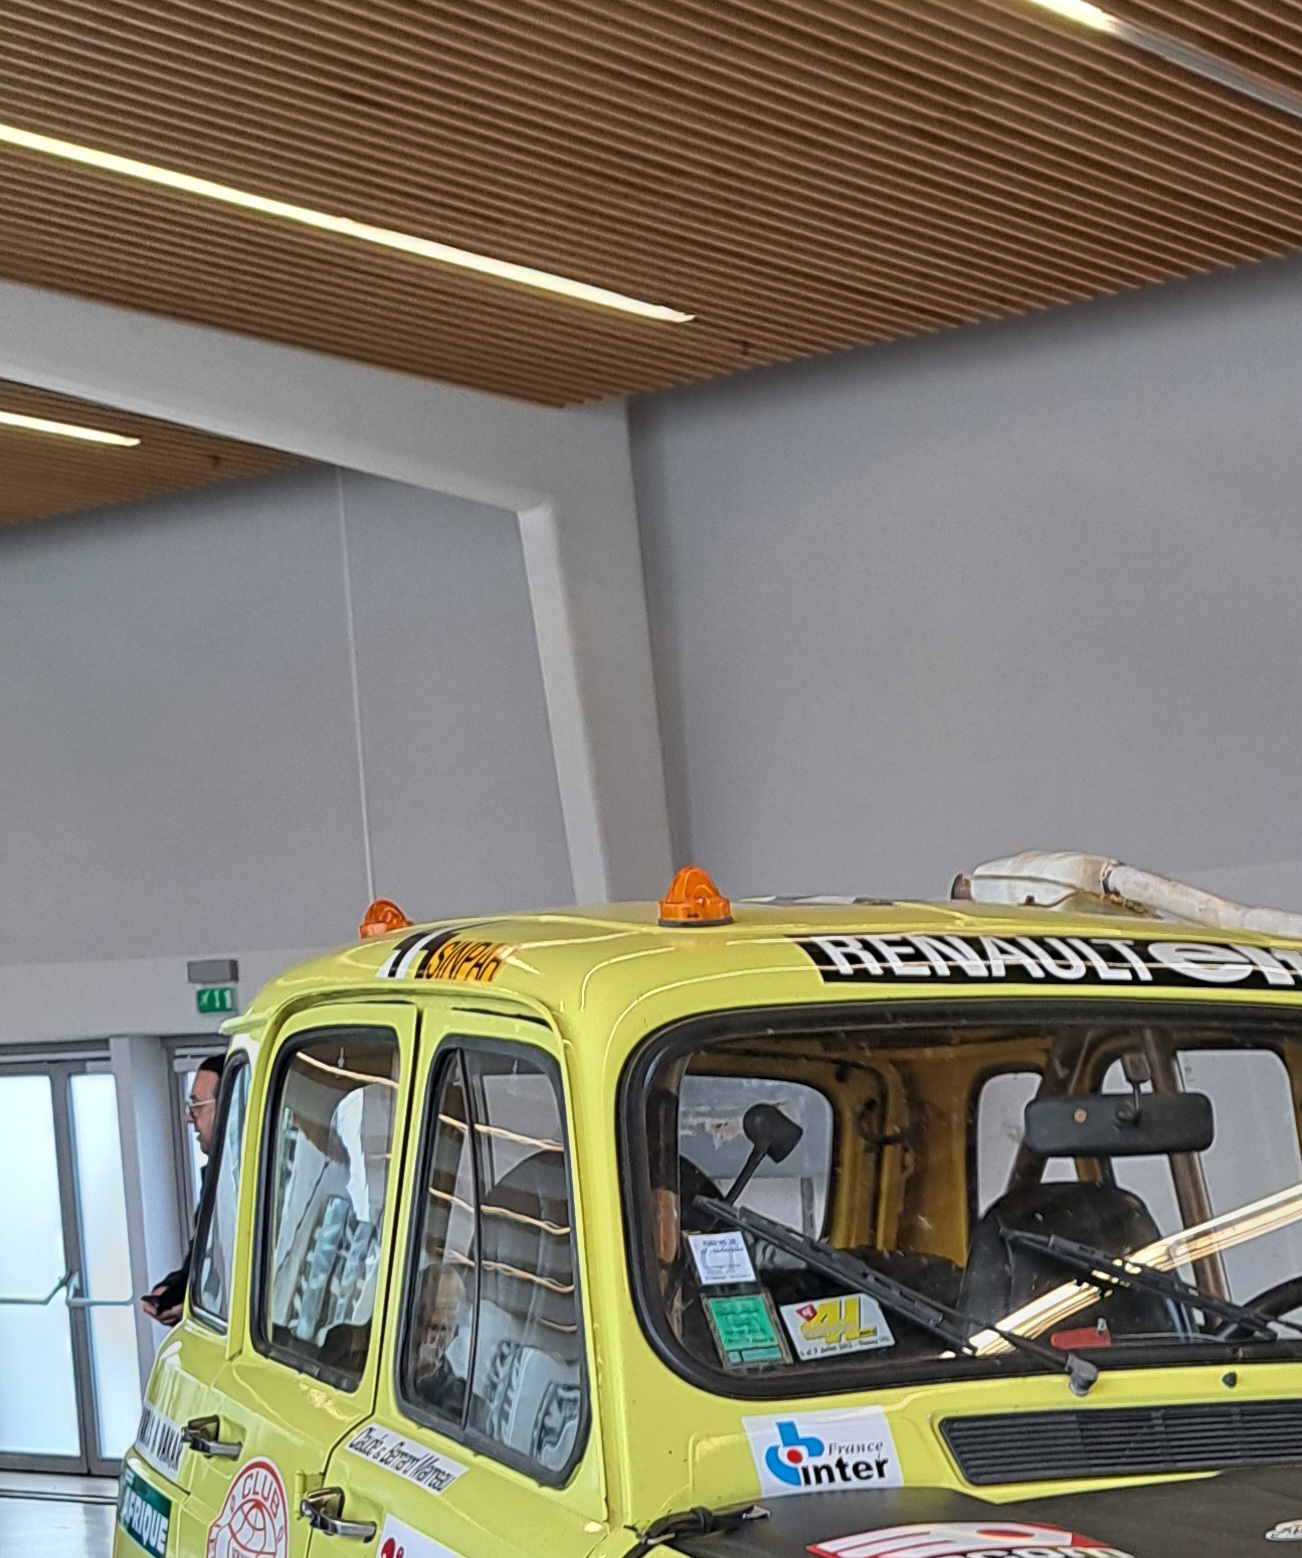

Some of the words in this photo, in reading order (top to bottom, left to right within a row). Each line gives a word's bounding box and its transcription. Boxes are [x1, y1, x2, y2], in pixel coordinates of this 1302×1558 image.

[811, 934, 1153, 982] RENAULT
[828, 1440, 884, 1459] France
[801, 1456, 889, 1486] inter
[242, 1468, 279, 1518] CLUB
